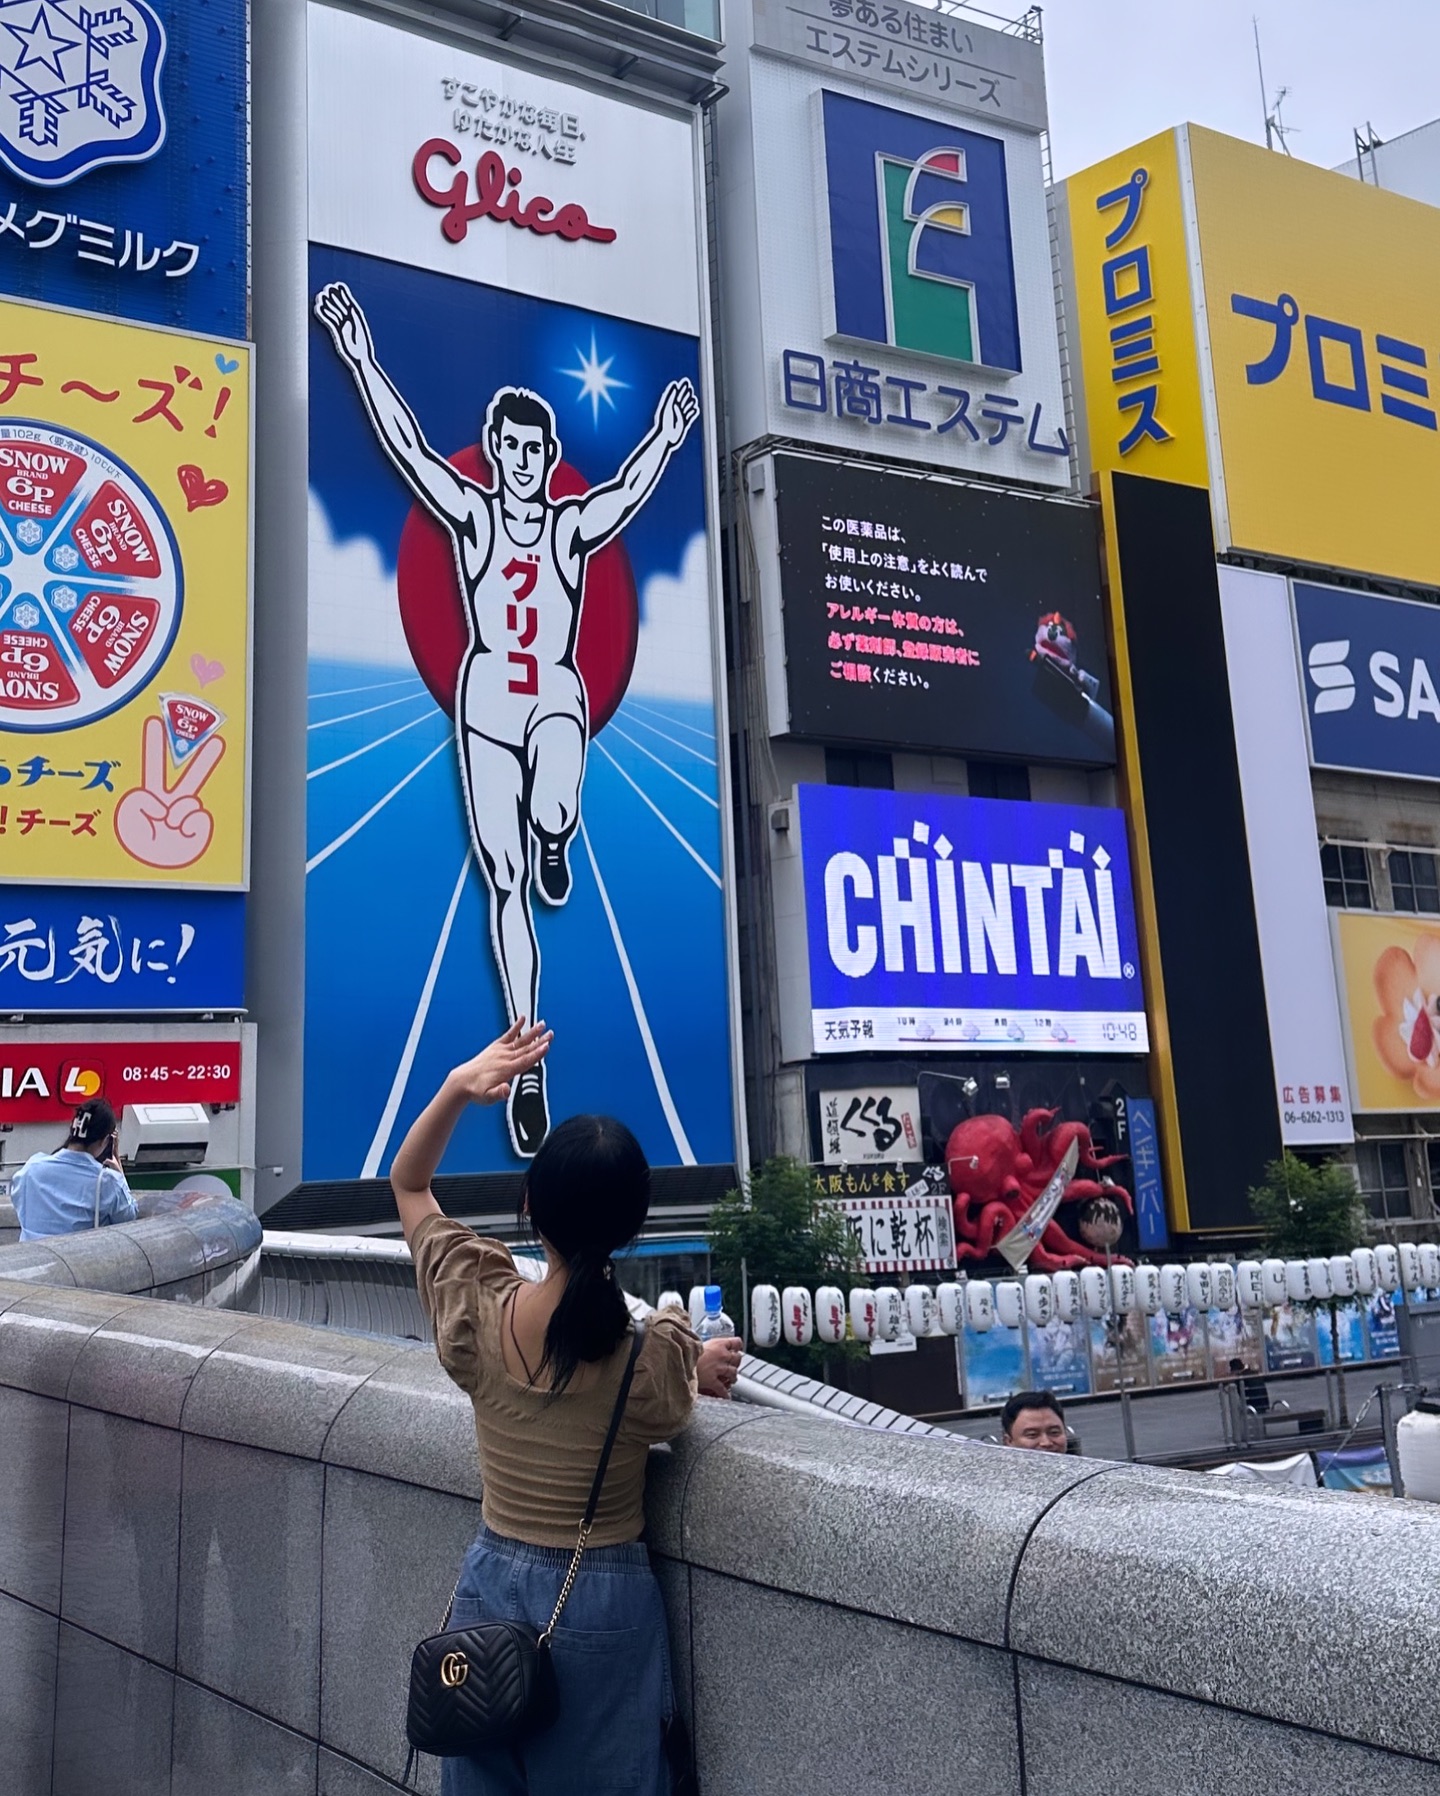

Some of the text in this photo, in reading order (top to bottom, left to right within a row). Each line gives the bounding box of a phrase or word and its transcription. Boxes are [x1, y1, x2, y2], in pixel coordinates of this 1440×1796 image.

[806, 26, 1001, 107] エステムシリーズ
[453, 109, 577, 166] ゆたかな人生
[411, 138, 617, 244] Glico
[0, 203, 199, 277] メグミルク
[1096, 168, 1175, 457] プロミス
[783, 349, 1070, 456] 日商エステム
[0, 447, 70, 475] SNOW
[16, 469, 49, 480] BRAND
[6, 476, 55, 503] 6P
[8, 500, 52, 514] CHEESE
[90, 518, 117, 563] 6P
[107, 499, 153, 563] SNOW
[109, 522, 127, 551] BRAND
[821, 515, 906, 544] この医薬品は、
[75, 528, 102, 569] CHEESE
[824, 574, 921, 603] お使いください。
[72, 595, 101, 633] CHEESE
[87, 605, 120, 644] 6P
[501, 553, 541, 696] グリコ
[3, 634, 48, 648] CHEESE
[103, 610, 149, 676] SNOW
[105, 621, 125, 648] BRAND
[1, 647, 49, 673] 6P
[7, 671, 40, 680] BRAND
[175, 704, 209, 722] SNOW
[177, 717, 199, 733] 6P
[825, 1020, 874, 1041] 天気予報
[1283, 1086, 1342, 1104] 広告募集
[841, 1096, 902, 1152] くくる
[1284, 1110, 1345, 1124] 06-6262-1313
[931, 1182, 947, 1195] 2F
